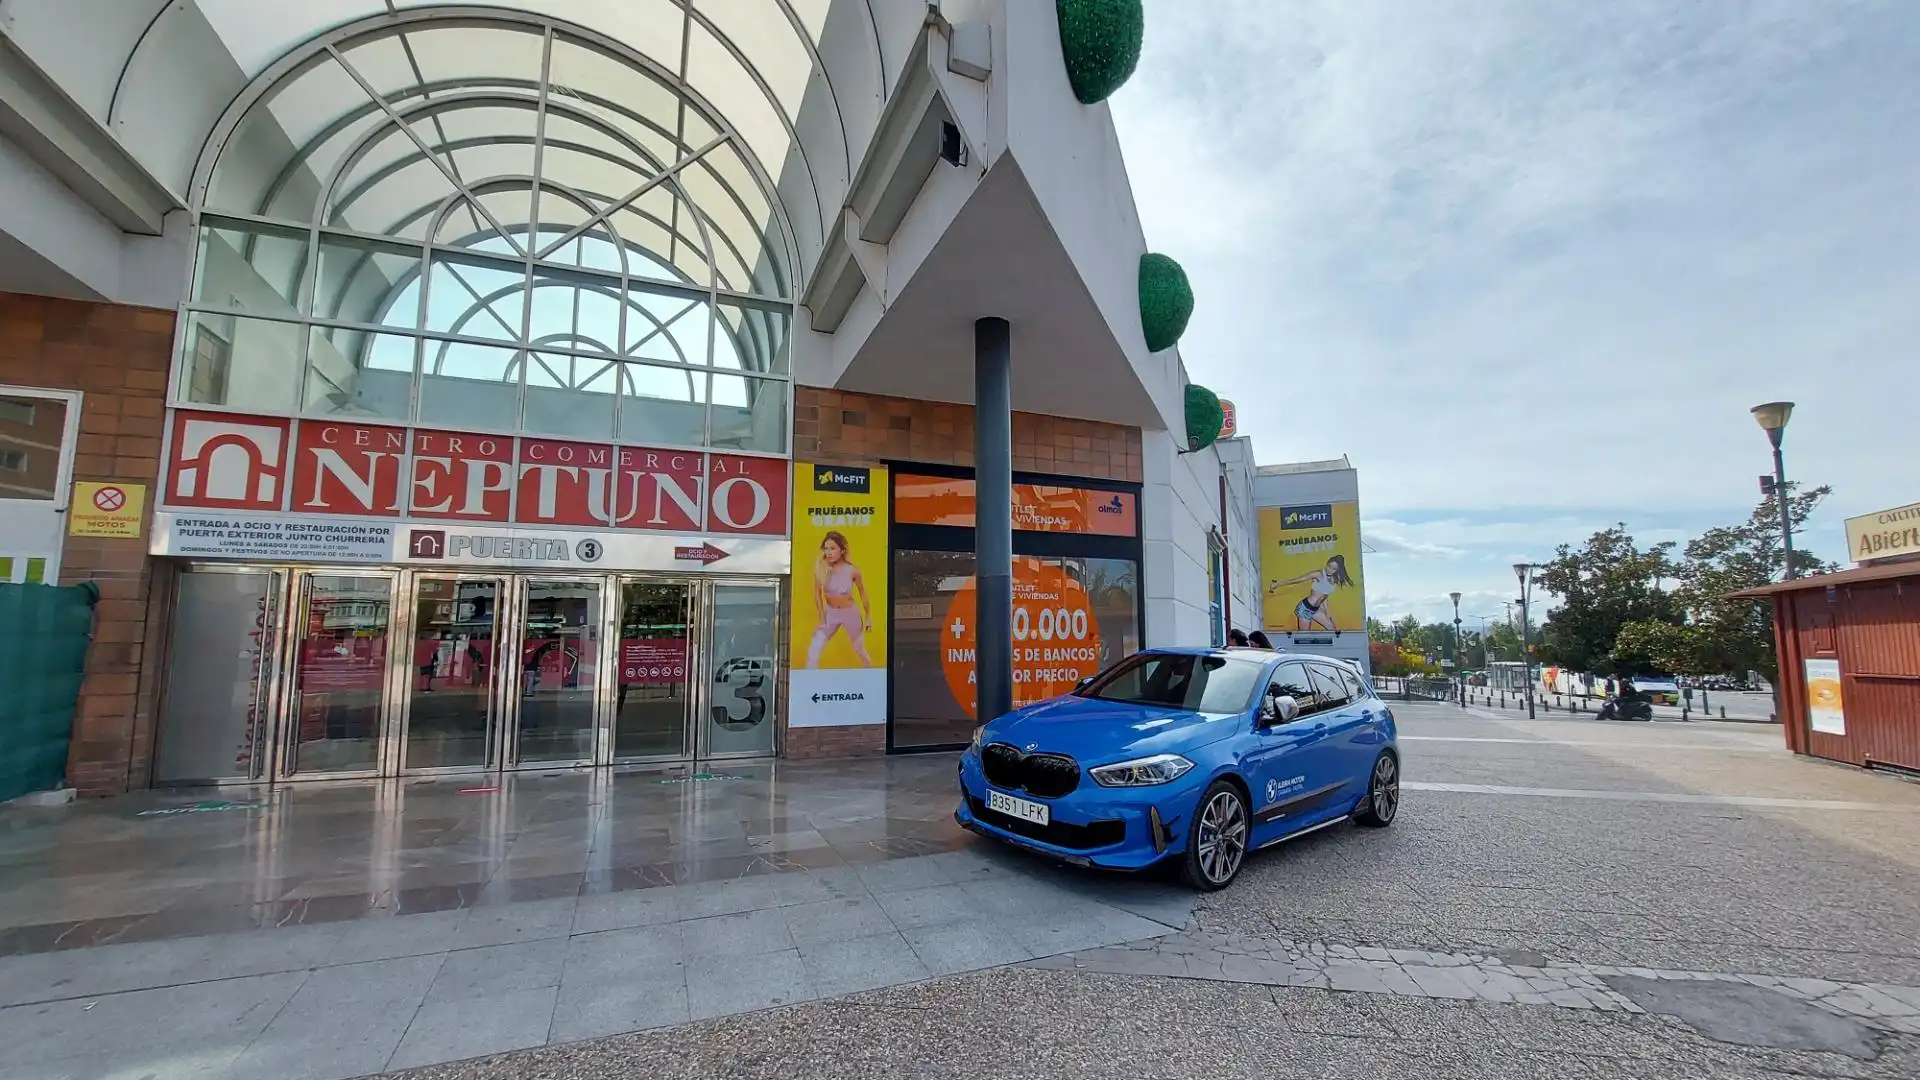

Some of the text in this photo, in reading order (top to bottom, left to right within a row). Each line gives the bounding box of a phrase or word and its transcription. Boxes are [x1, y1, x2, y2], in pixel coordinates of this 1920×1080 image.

[321, 427, 751, 475] CENTRO COMERCIAL
[834, 474, 866, 485] McFIT
[303, 447, 771, 529] NEPTUNO
[807, 504, 876, 516] PRUÉBANOS
[1299, 512, 1328, 521] McFIT
[1015, 513, 1067, 526] VIVIENDAS
[176, 519, 390, 536] ENTRADA A OCIO Y RESTAURACIÓN POR
[179, 528, 385, 544] PUERTA EXTERIOR JUNTO CHURRERÍA
[449, 535, 570, 561] PUERTA
[1024, 649, 1040, 661] DE
[1043, 647, 1096, 661] BANCOS
[1035, 668, 1079, 682] PRECIO
[821, 692, 864, 701] ENTRADA
[992, 793, 1044, 822] 8351 LFK
